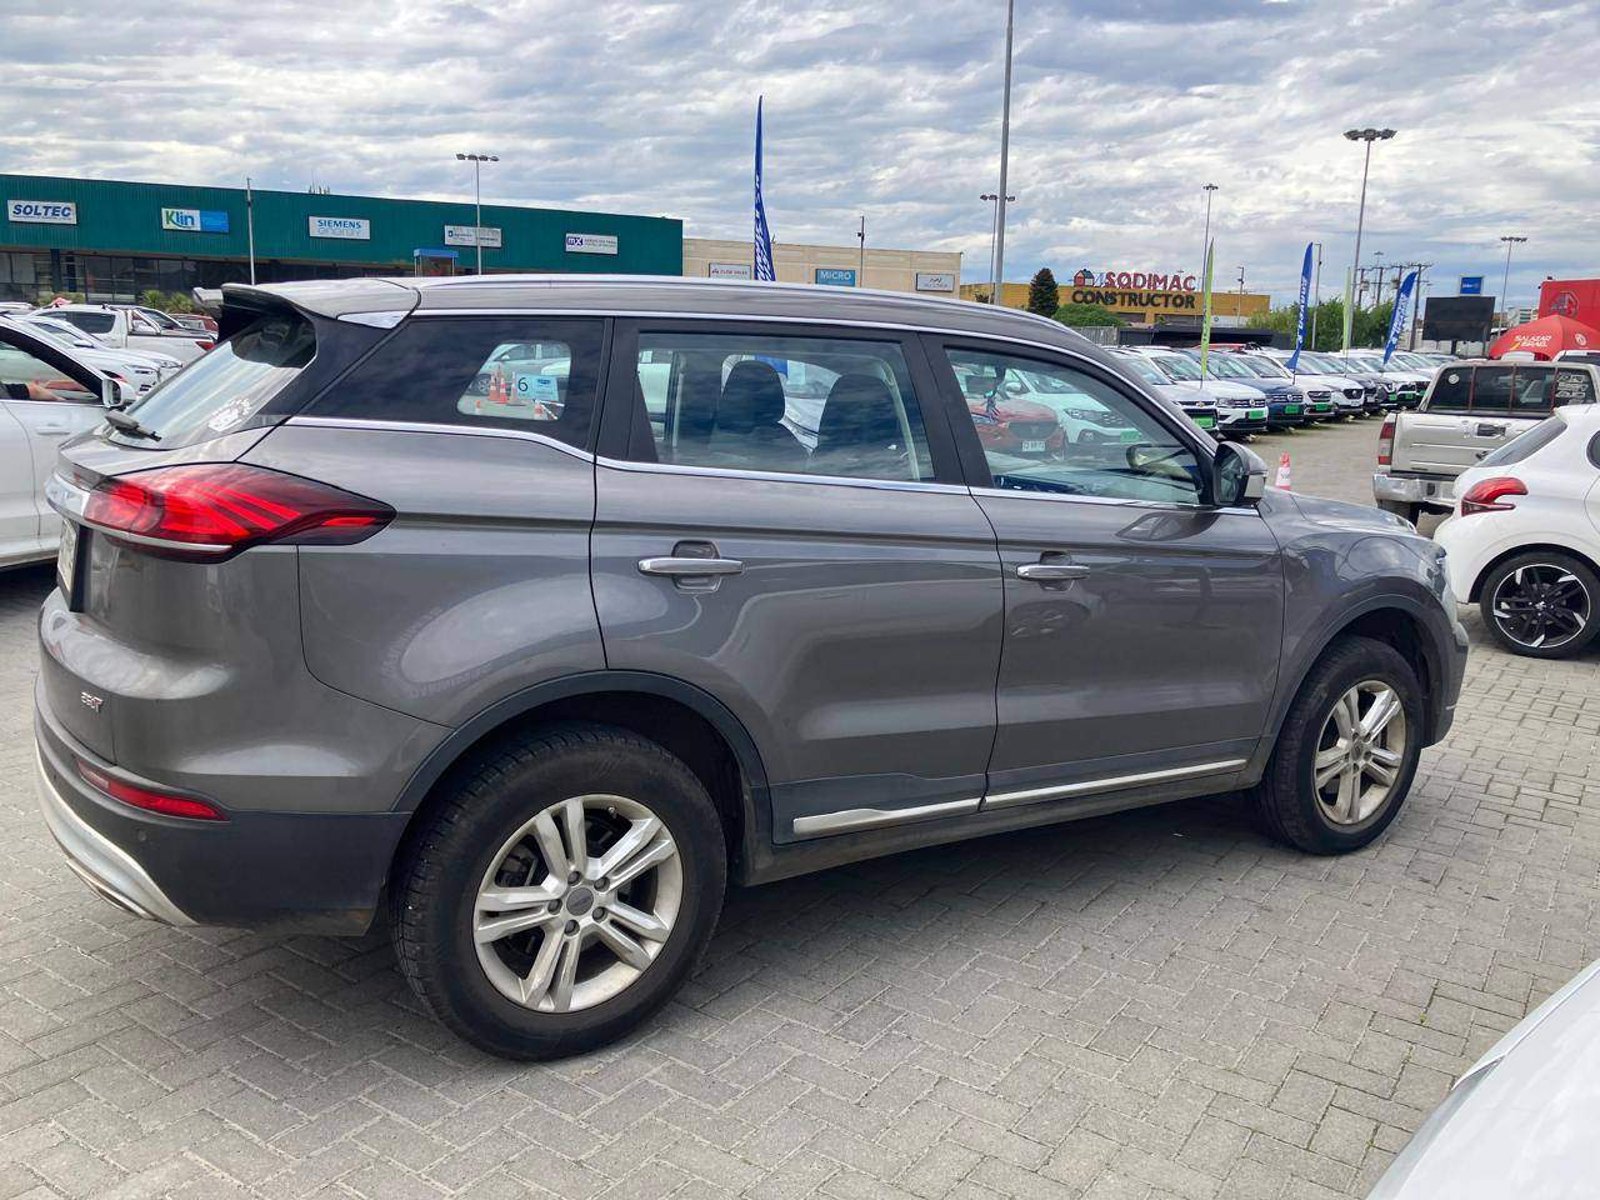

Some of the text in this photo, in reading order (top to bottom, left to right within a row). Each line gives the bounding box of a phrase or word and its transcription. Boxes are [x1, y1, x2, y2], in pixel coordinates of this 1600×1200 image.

[13, 204, 71, 217] SOLTEC
[165, 210, 195, 228] Klin
[317, 219, 361, 229] SIEMENS
[820, 270, 851, 280] MICRO
[1104, 271, 1196, 291] SODIMAC
[1072, 290, 1196, 309] CONSTRUCTOR
[518, 377, 528, 392] 6
